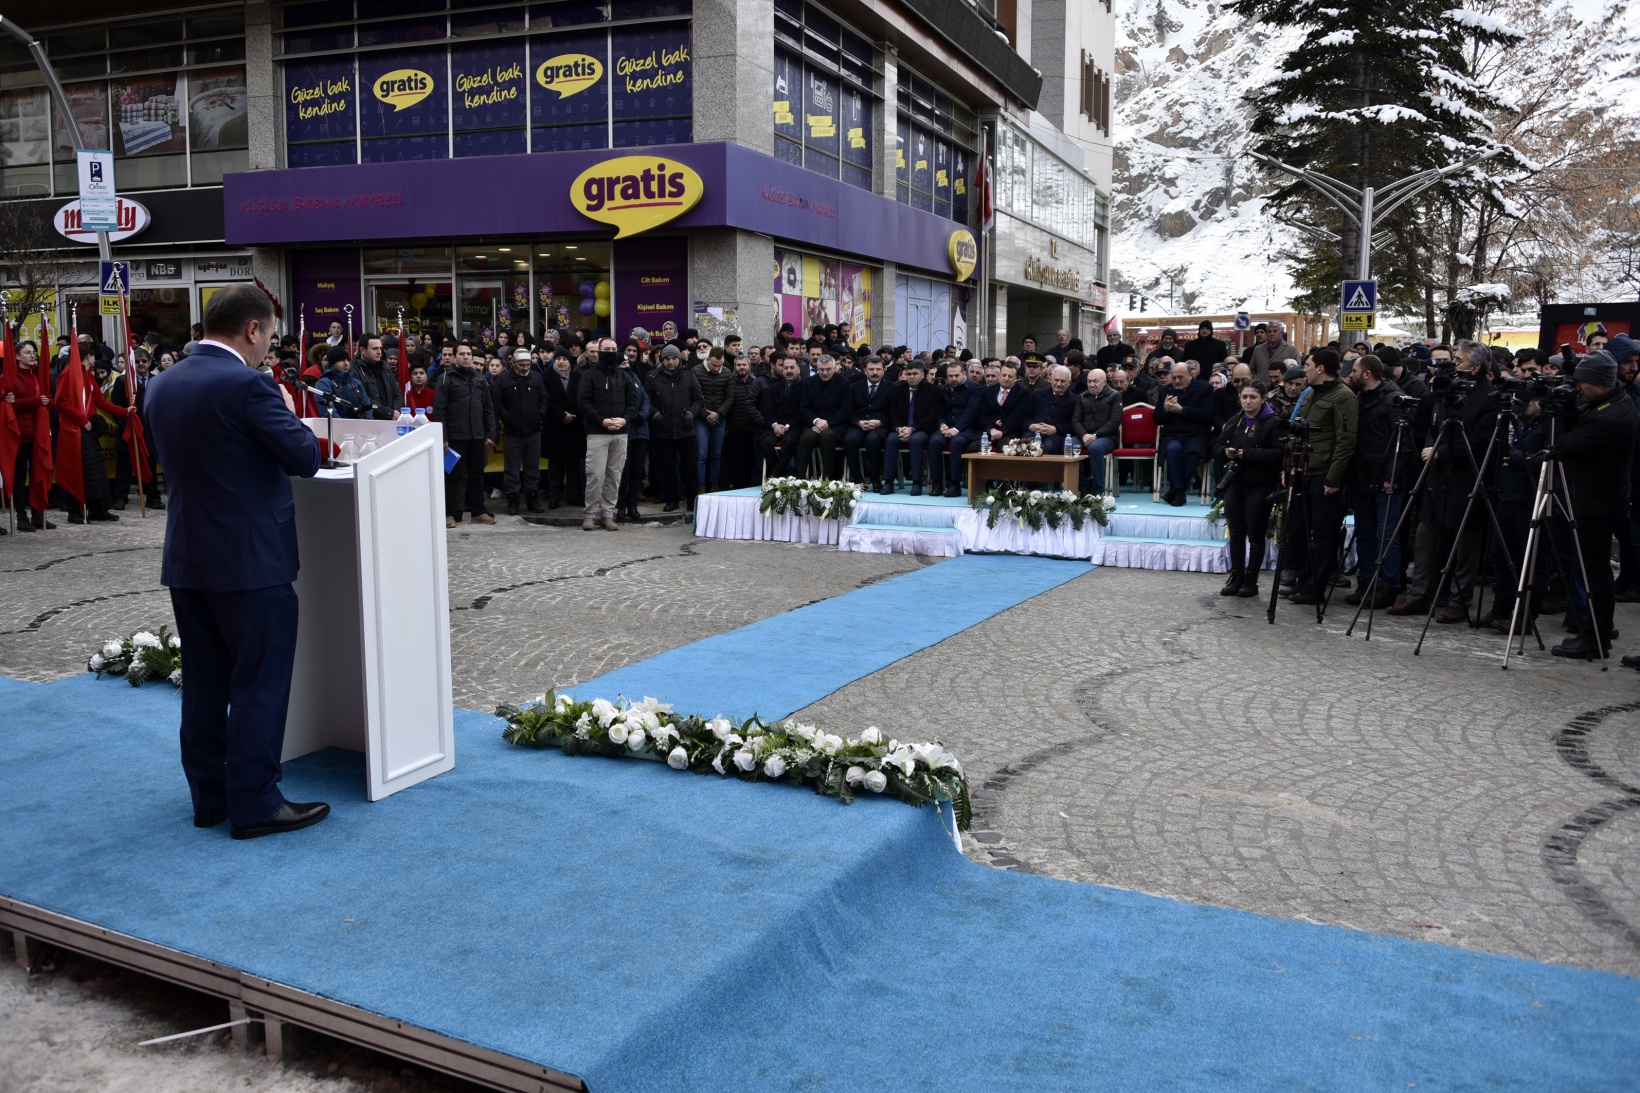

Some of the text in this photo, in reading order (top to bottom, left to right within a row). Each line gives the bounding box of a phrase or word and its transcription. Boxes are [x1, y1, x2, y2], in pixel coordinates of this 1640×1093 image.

[543, 57, 596, 85] gratis
[616, 45, 691, 76] Güzel bak
[379, 72, 428, 98] gratis
[456, 62, 523, 92] Güzel bak
[626, 69, 684, 94] kendine
[291, 76, 351, 104] Güzel bak
[464, 86, 518, 109] kendine
[299, 98, 346, 120] kendine
[583, 163, 686, 212] gratis
[240, 197, 288, 216] Kişisel
[956, 237, 975, 263] gratis
[151, 263, 176, 276] NBB
[103, 298, 119, 306] İLK
[1345, 315, 1363, 323] İLK
